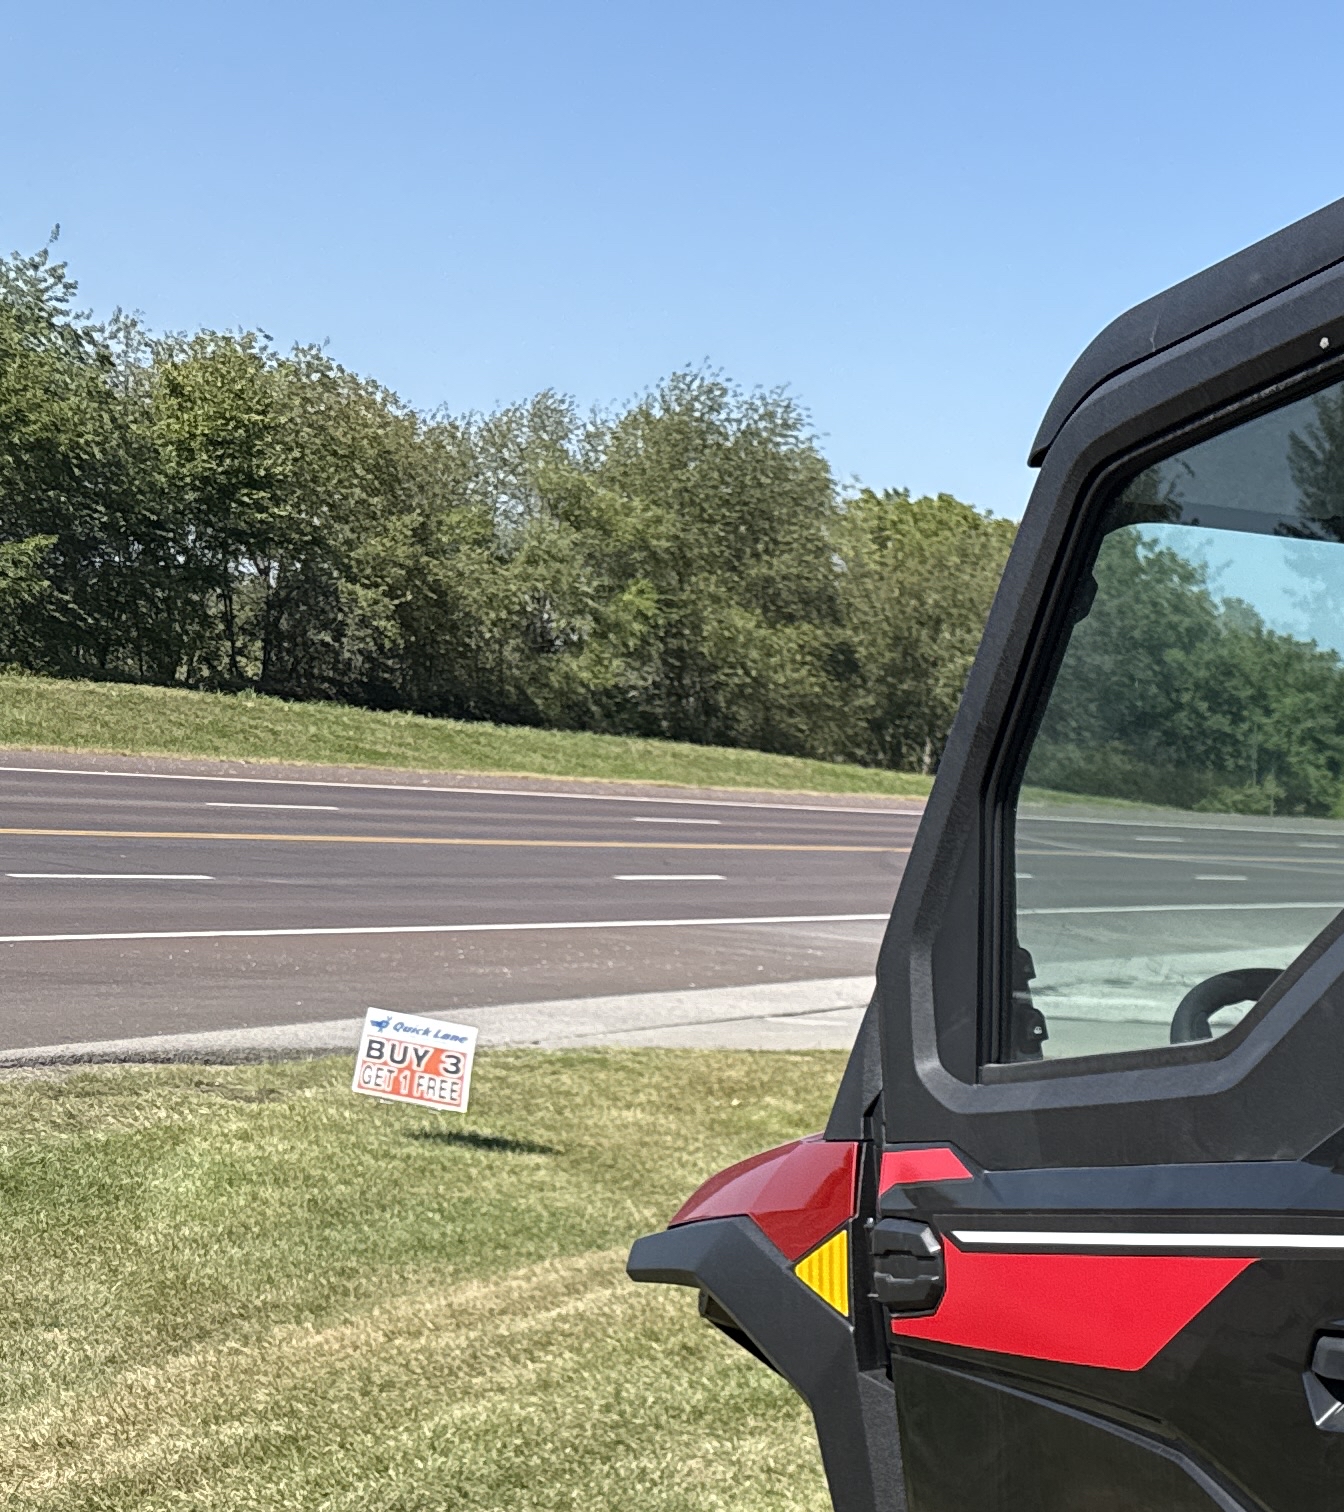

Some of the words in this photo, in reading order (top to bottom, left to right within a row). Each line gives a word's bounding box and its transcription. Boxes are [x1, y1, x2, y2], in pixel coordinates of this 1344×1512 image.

[392, 1021, 432, 1037] Quick
[432, 1029, 469, 1044] Lane
[366, 1039, 430, 1068] BUY
[443, 1054, 463, 1075] 3
[362, 1064, 396, 1089] GET
[400, 1074, 408, 1092] 1
[416, 1074, 460, 1102] FREE
